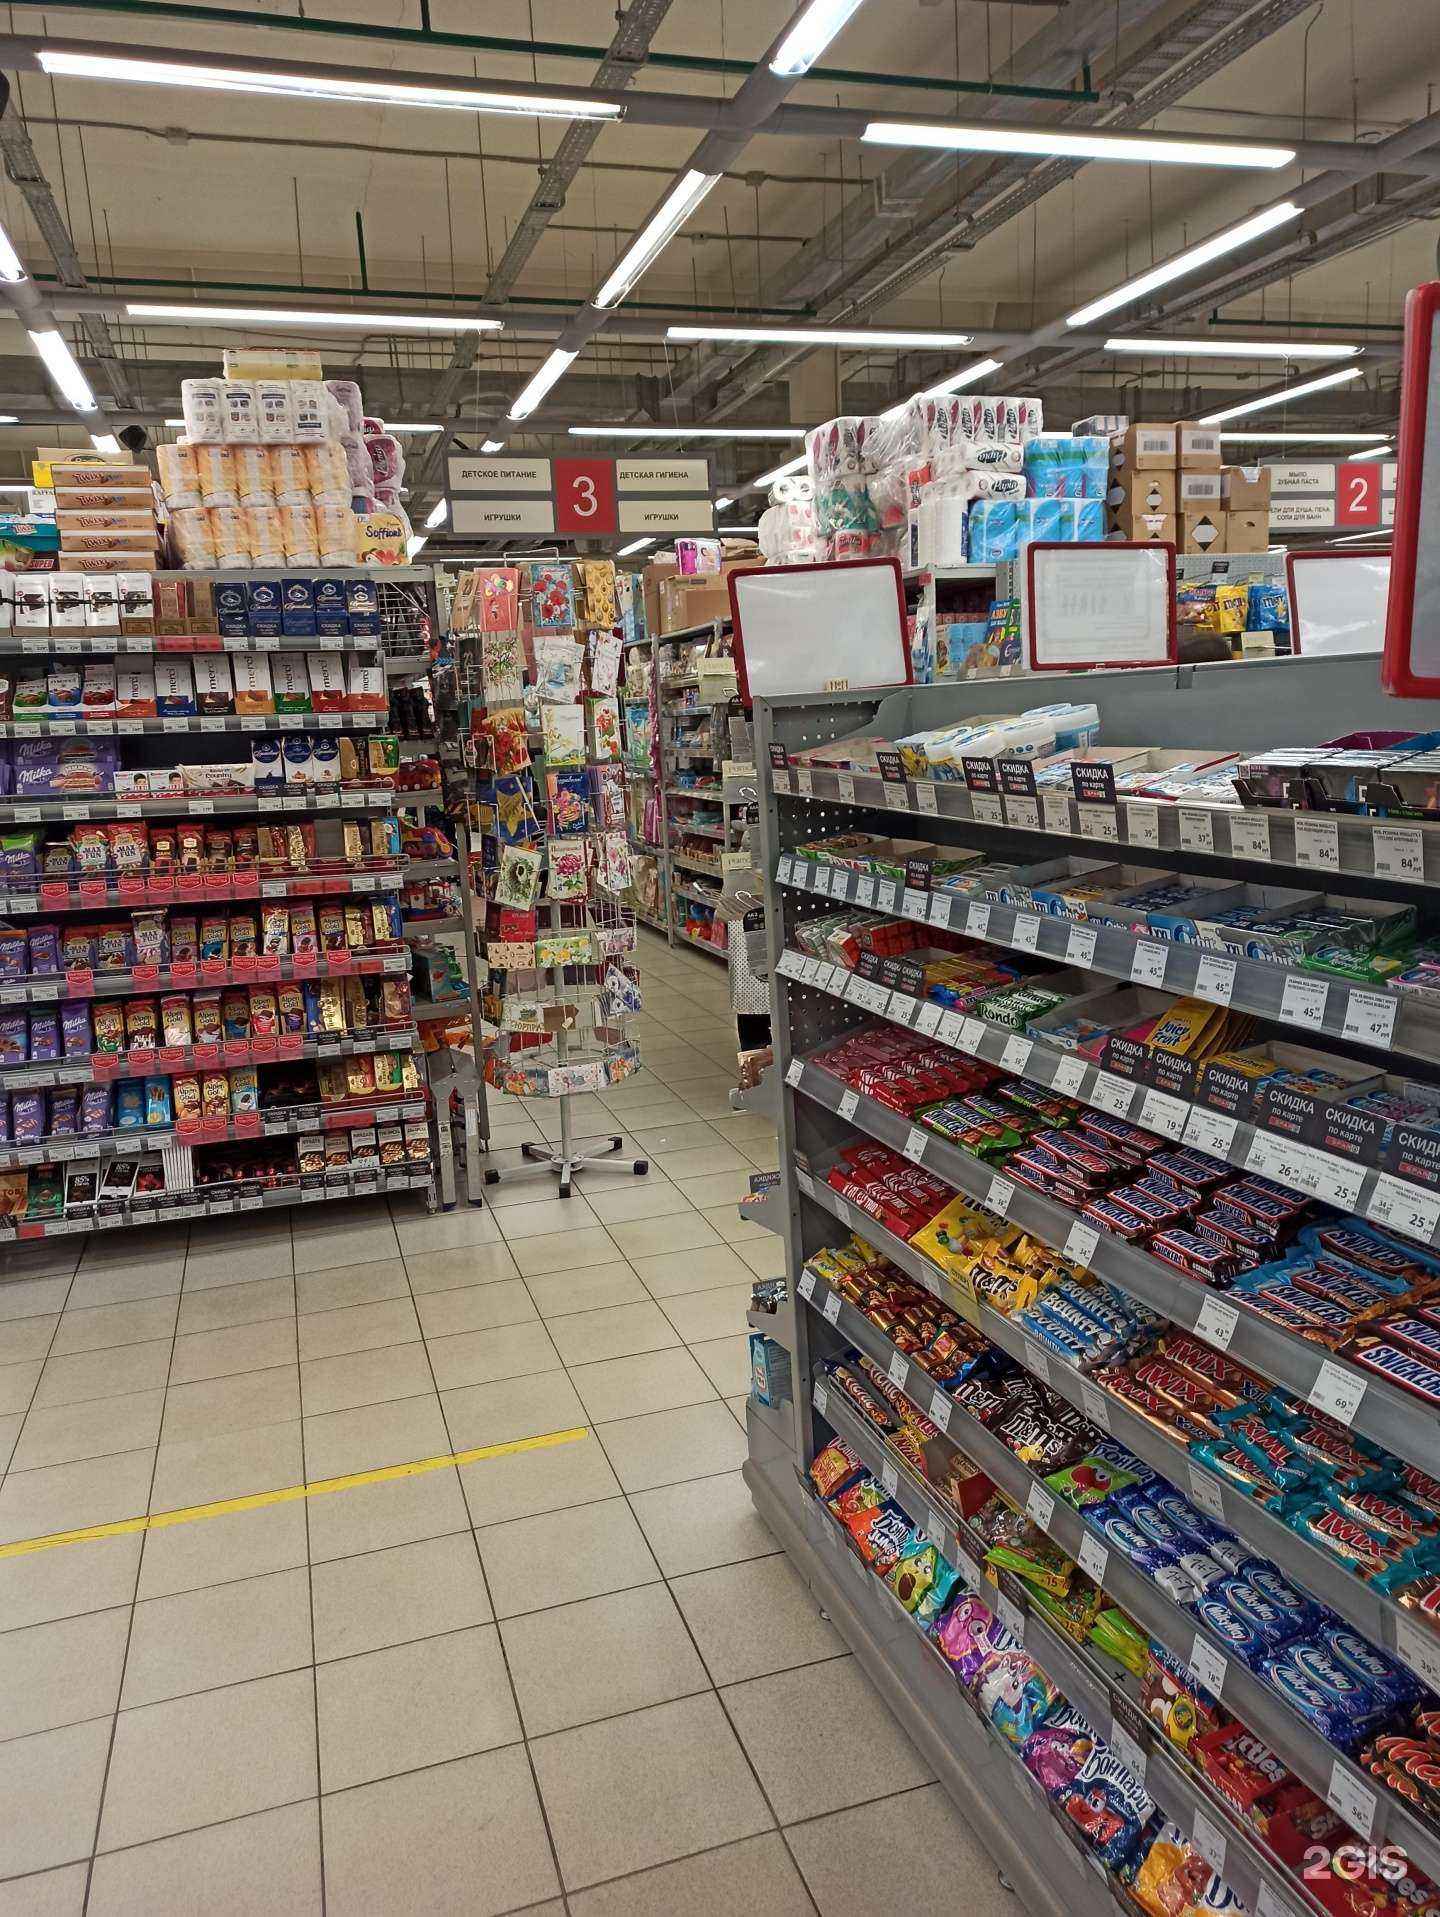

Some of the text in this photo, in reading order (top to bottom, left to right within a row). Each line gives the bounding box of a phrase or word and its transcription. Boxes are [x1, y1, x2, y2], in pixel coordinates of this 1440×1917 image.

[462, 470, 537, 478] ДЕТСКОЕ ПИТАНИЕ
[619, 471, 688, 479] ДЕТСКАЯ ГИГИЕНА
[572, 476, 598, 516] 3
[1349, 478, 1368, 511] 2
[484, 513, 521, 521] ИГРУШКИ
[644, 513, 679, 521] ИГРУШКИ
[879, 755, 900, 764] СКИДКА
[965, 761, 991, 771] СКИДКА
[1002, 763, 1030, 774] СКИДКА
[19, 767, 53, 783] Milka
[1075, 767, 1108, 779] СКИДКА
[1103, 825, 1112, 835] 25
[1252, 840, 1262, 850] 84
[1319, 849, 1329, 858] 84
[1401, 859, 1412, 868] 84
[1149, 967, 1157, 976] 45
[1303, 1007, 1313, 1017] 45
[1161, 1021, 1189, 1035] Juicy
[1370, 1023, 1381, 1033] 47
[1152, 1032, 1182, 1047] Fruit
[1110, 1038, 1144, 1057] СКИДКА
[1156, 1053, 1192, 1074] СКИДКА
[1209, 1069, 1249, 1093] СКИДКА
[1211, 1085, 1239, 1101] по карте
[1113, 1098, 1124, 1109] 25
[1269, 1090, 1315, 1115] СКИДКА
[1272, 1107, 1304, 1123] по карте
[1325, 1107, 1376, 1134] СКИДКА
[1166, 1119, 1176, 1130] 19
[1328, 1125, 1364, 1144] по карте
[1212, 1137, 1223, 1148] 25
[1398, 1132, 1440, 1157] СКИД
[1402, 1151, 1414, 1161] по
[1278, 1163, 1291, 1175] 26
[1335, 1185, 1348, 1198] 25
[1409, 1214, 1426, 1227] 25
[1153, 1241, 1183, 1265] SNICKERS
[1047, 1291, 1102, 1337] BOUNTY
[1363, 1347, 1440, 1396] SNICKE
[1335, 1399, 1347, 1409] 69
